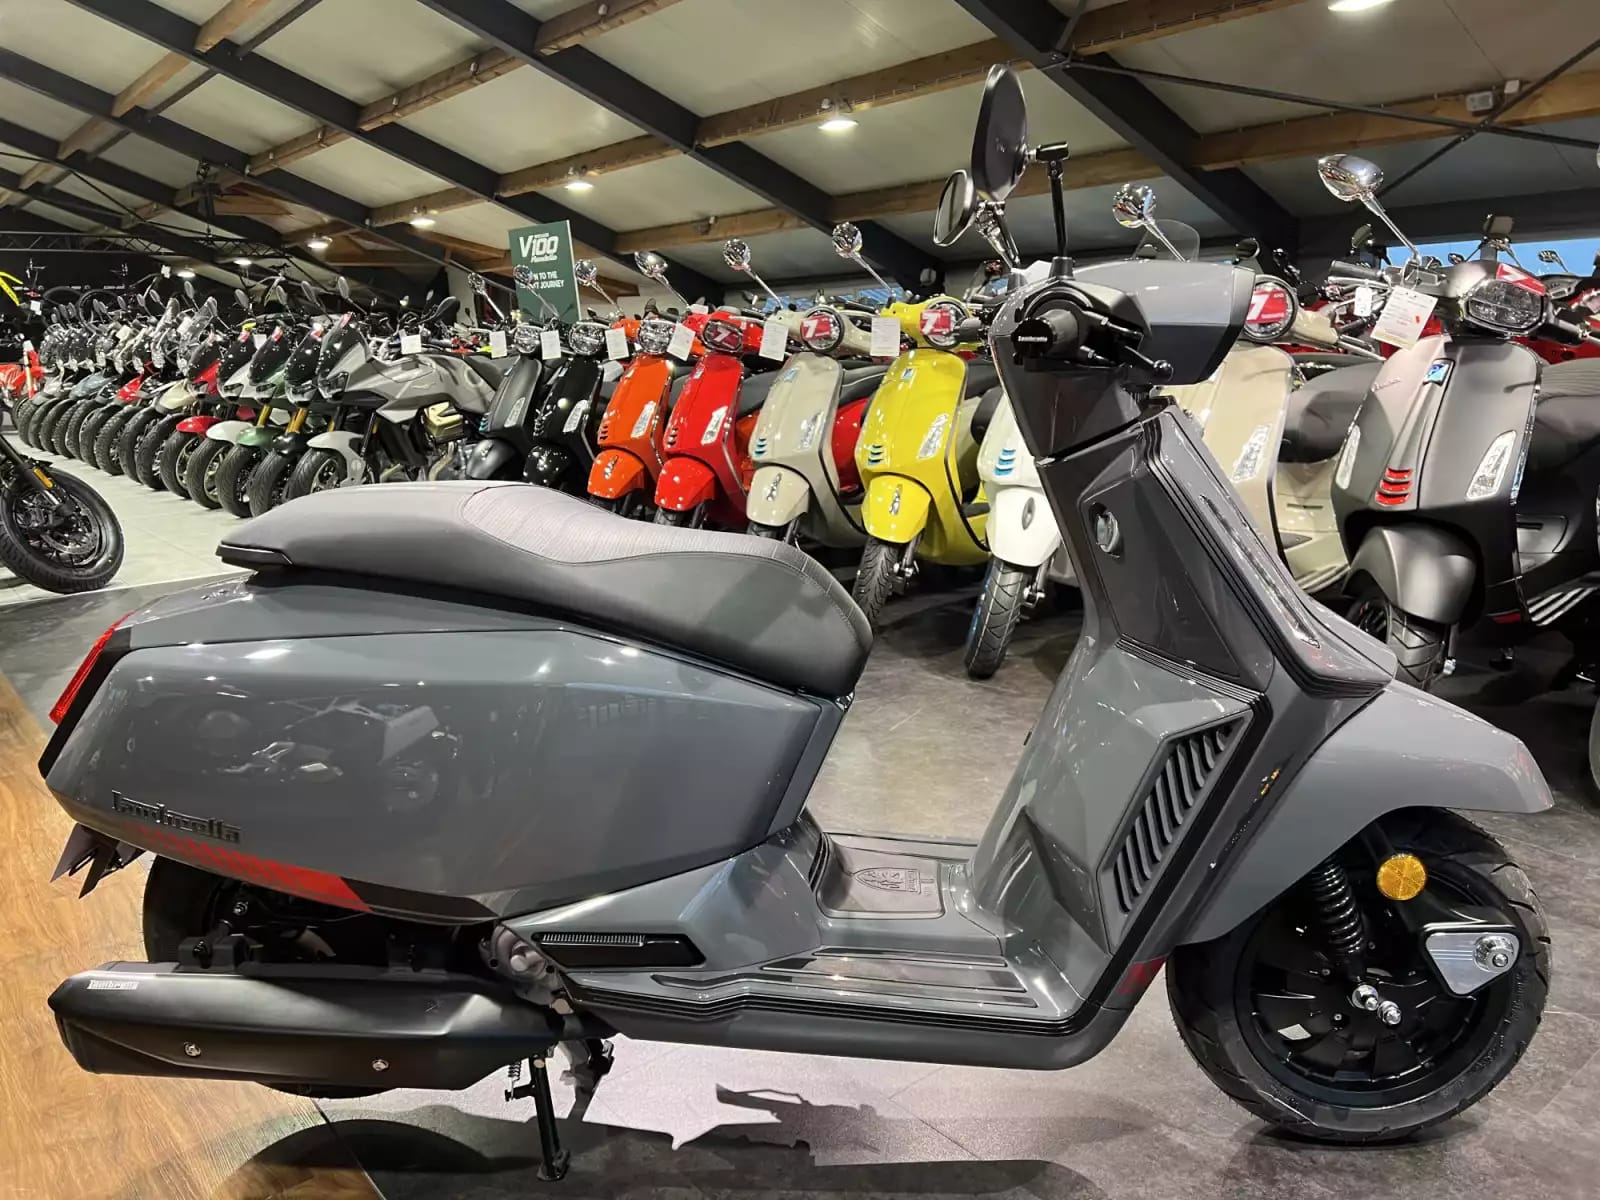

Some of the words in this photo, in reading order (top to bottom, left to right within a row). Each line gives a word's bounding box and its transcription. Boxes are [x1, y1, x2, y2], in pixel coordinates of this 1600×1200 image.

[519, 234, 559, 258] V100
[539, 272, 547, 280] TO
[547, 270, 558, 279] THE
[540, 279, 565, 289] JOURNEY
[802, 319, 819, 339] 7
